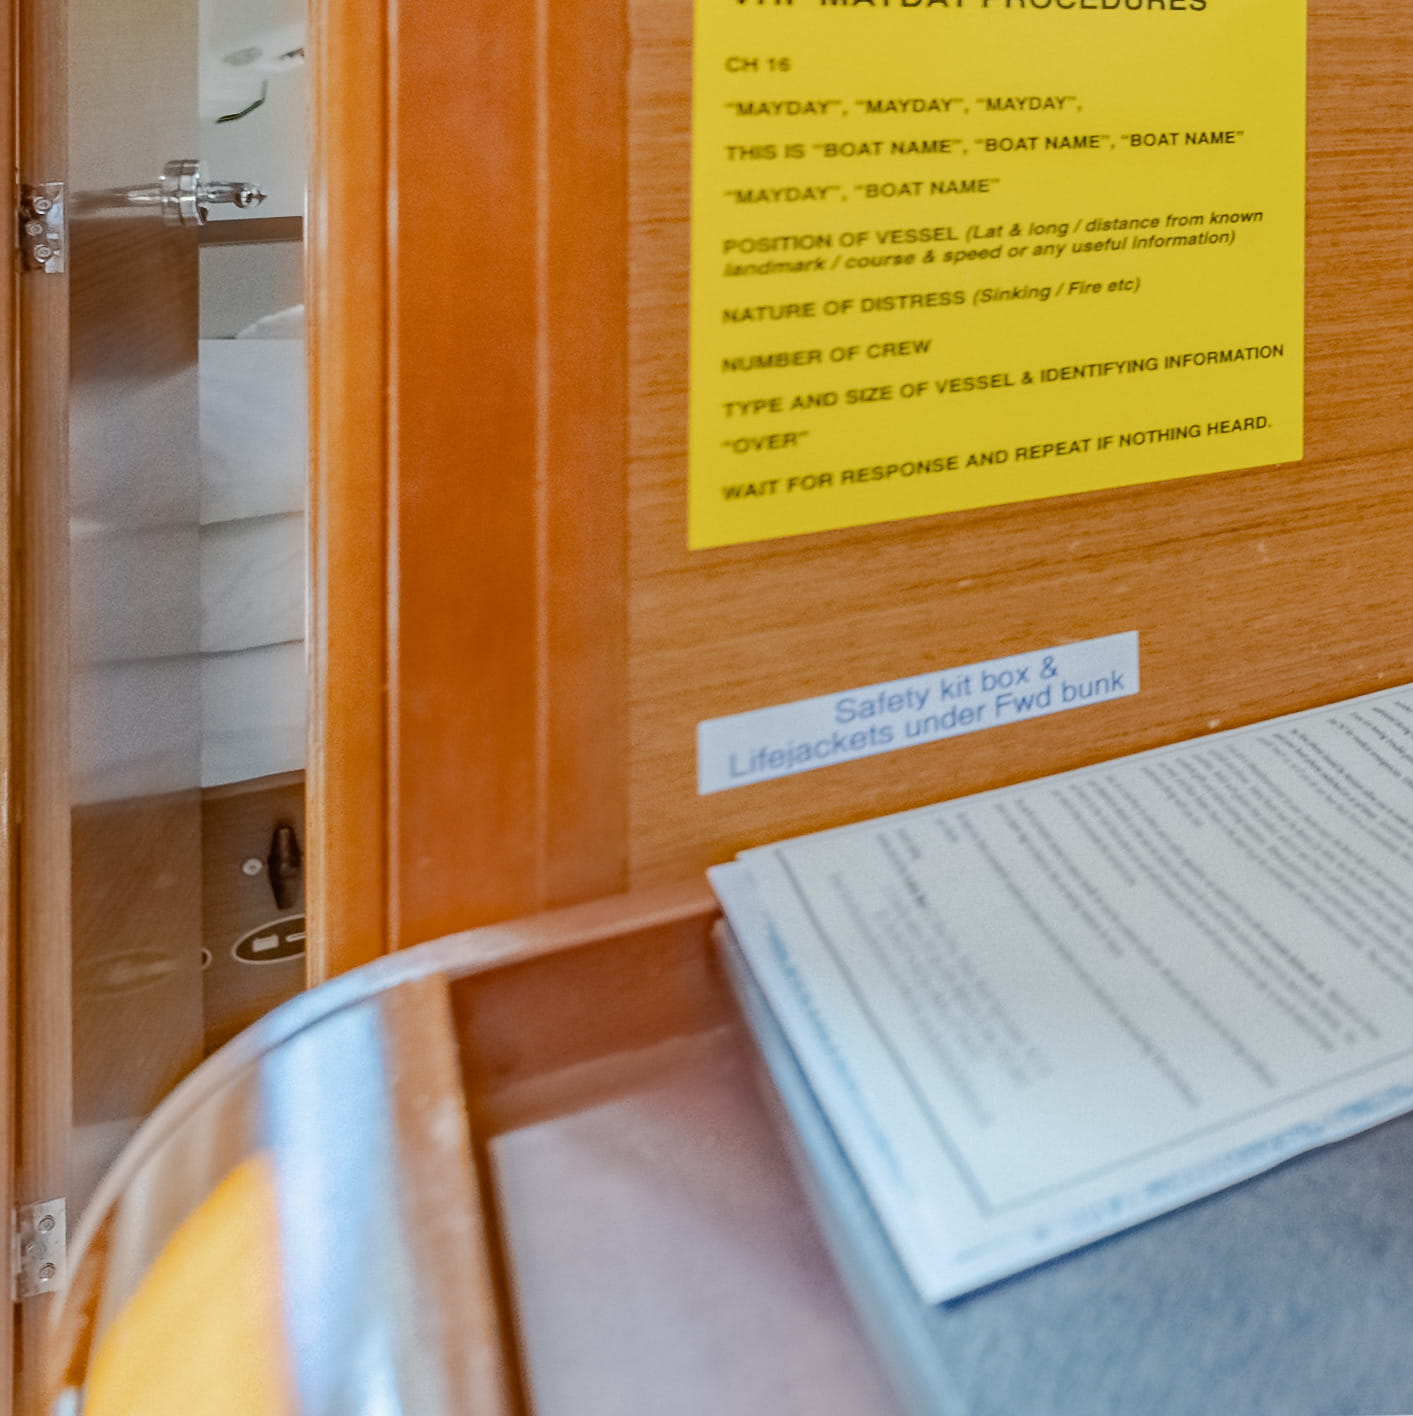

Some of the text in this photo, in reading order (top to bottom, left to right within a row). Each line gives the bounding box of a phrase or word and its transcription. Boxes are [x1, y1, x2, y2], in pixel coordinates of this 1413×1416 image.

[724, 56, 792, 73] CH 16
[725, 144, 778, 161] THIS
[784, 143, 806, 159] IS
[722, 211, 1264, 255] POSITION OF VESSEL (Lat & long / distance from known
[723, 230, 1236, 277] landmark / course & speed or any useful information)
[722, 276, 1141, 324] NATURE OF DISTRESS (Sinking / Fire etc)
[722, 338, 932, 373] NUMBER OF CREW
[723, 344, 1284, 418] TYPE AND SIZE OF VESSEL & IDENTIFYING INFORMATION
[721, 416, 1272, 501] WAIT FOR RESPONSE AND REPEAT IF NOTHING HEARD.
[834, 655, 1058, 724] Safety kit box &
[728, 670, 1125, 779] Lifejackets under Fwd bunk
